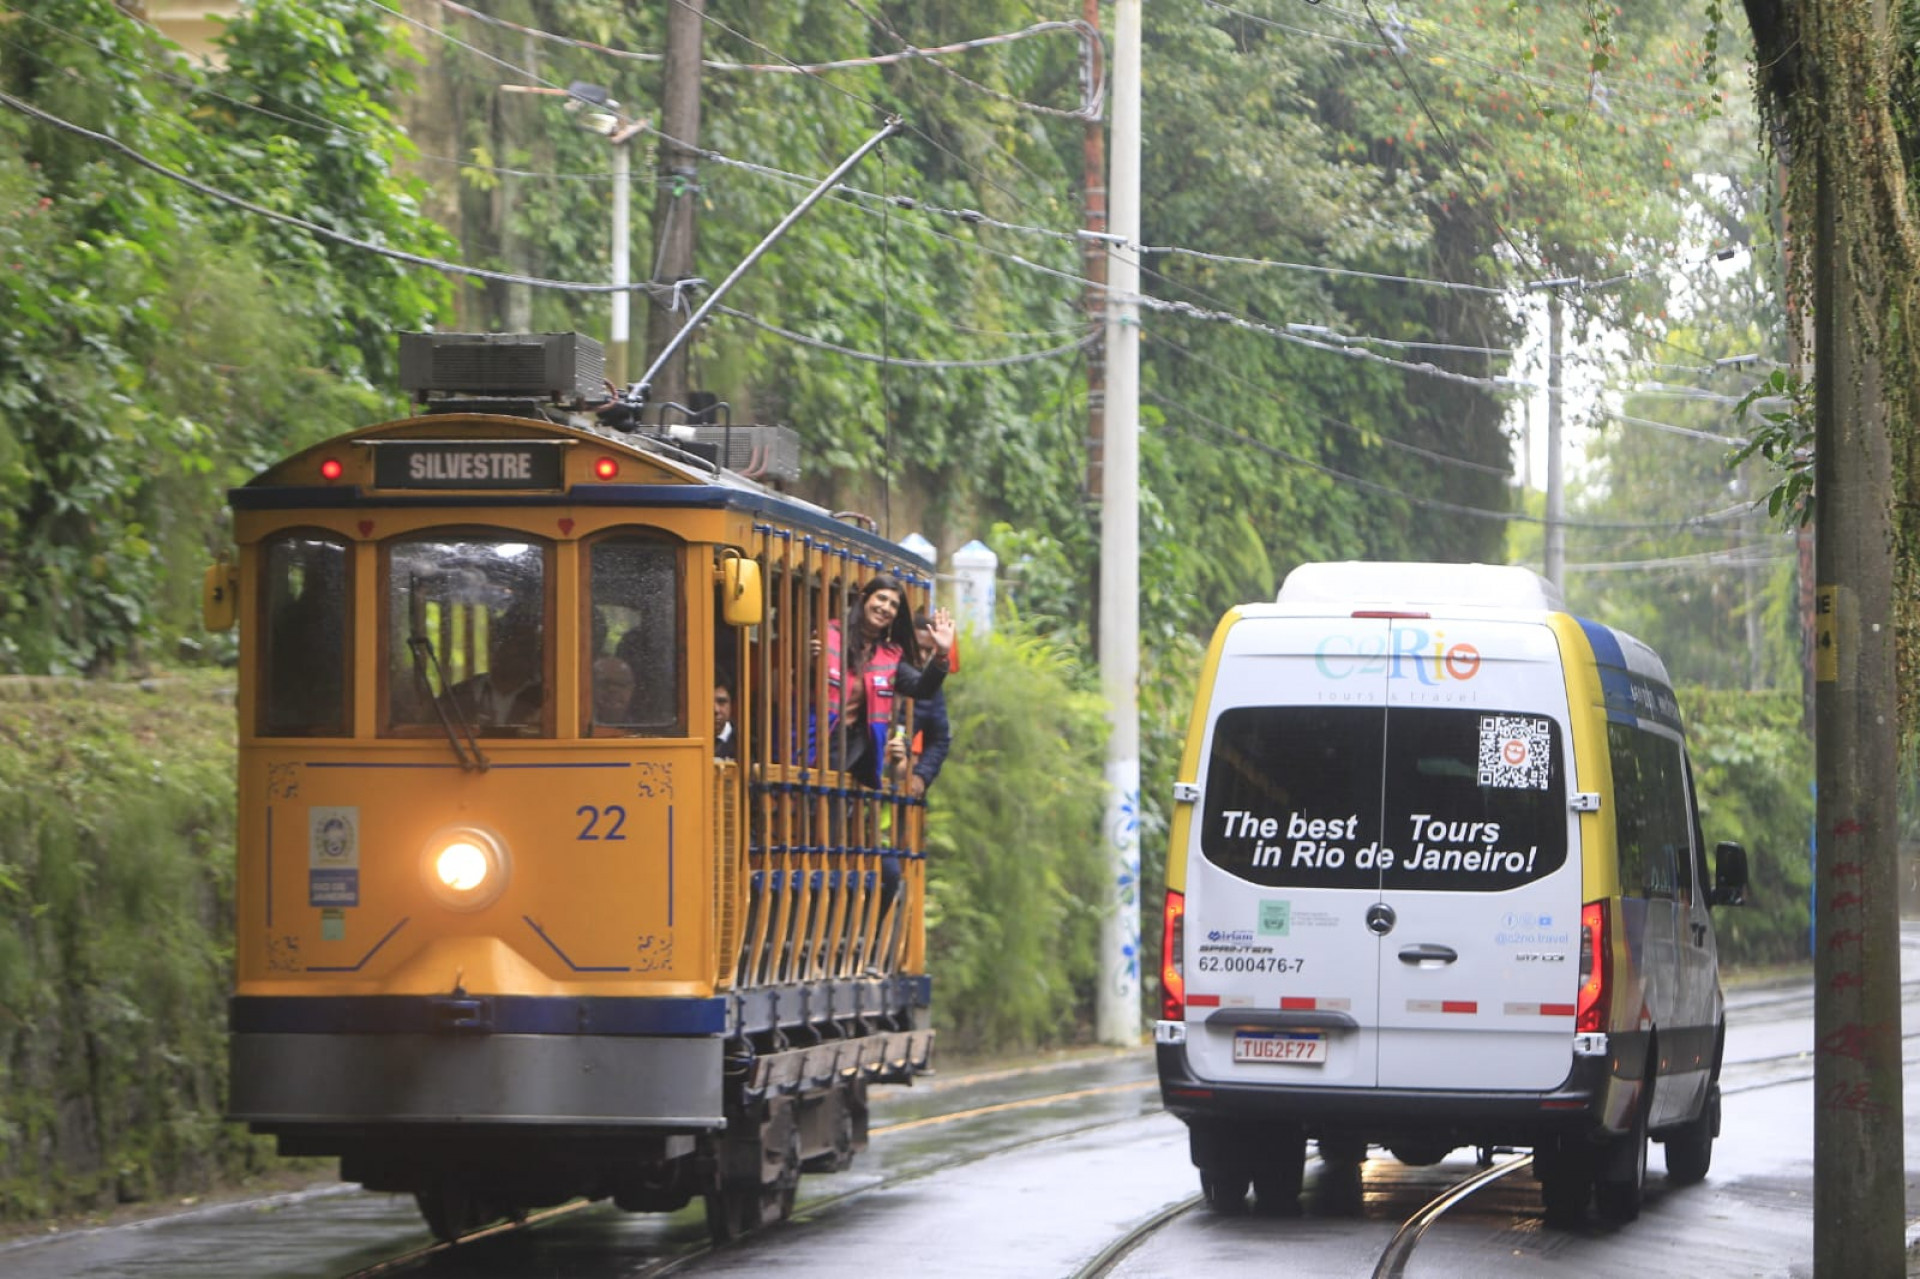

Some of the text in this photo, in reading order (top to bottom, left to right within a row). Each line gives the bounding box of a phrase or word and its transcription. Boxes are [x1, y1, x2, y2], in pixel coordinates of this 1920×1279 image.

[409, 452, 532, 480] SILVESTRE
[1315, 627, 1481, 686] C2Rio
[1317, 691, 1374, 701] tours
[1410, 691, 1478, 702] travel
[576, 805, 626, 840] 22
[1222, 810, 1501, 843] The best Tours
[1252, 840, 1537, 873] in Rio de Janeiro!
[1199, 956, 1305, 974] 62.000476-7
[1243, 1040, 1317, 1059] TUG2F77
